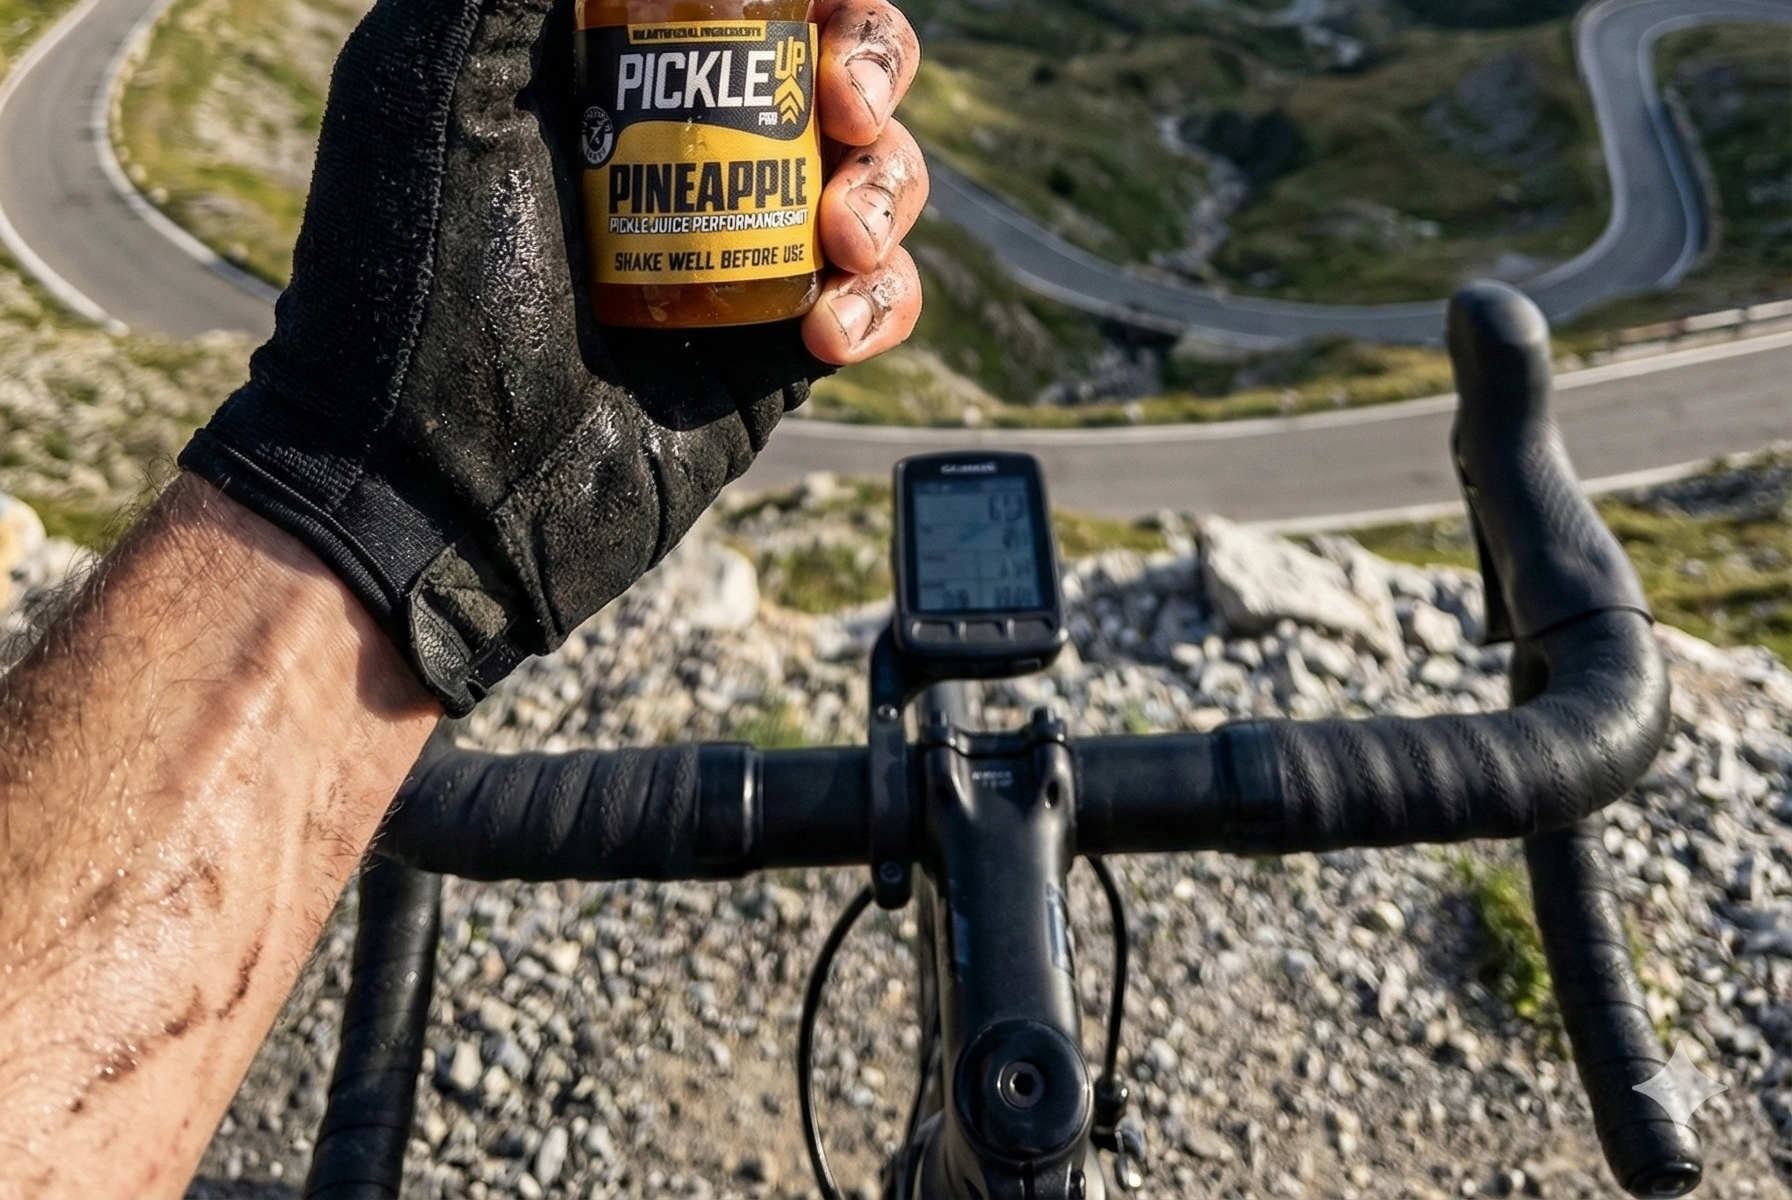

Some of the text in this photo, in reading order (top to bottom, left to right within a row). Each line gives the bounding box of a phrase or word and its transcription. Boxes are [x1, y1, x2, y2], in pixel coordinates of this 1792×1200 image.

[616, 36, 806, 110] PICKLE UP
[609, 157, 807, 214] PINEAPPLE
[609, 217, 649, 234] PICKLE
[650, 216, 690, 233] JUICE
[614, 243, 805, 271] SHAKE WELL BEFORE USE
